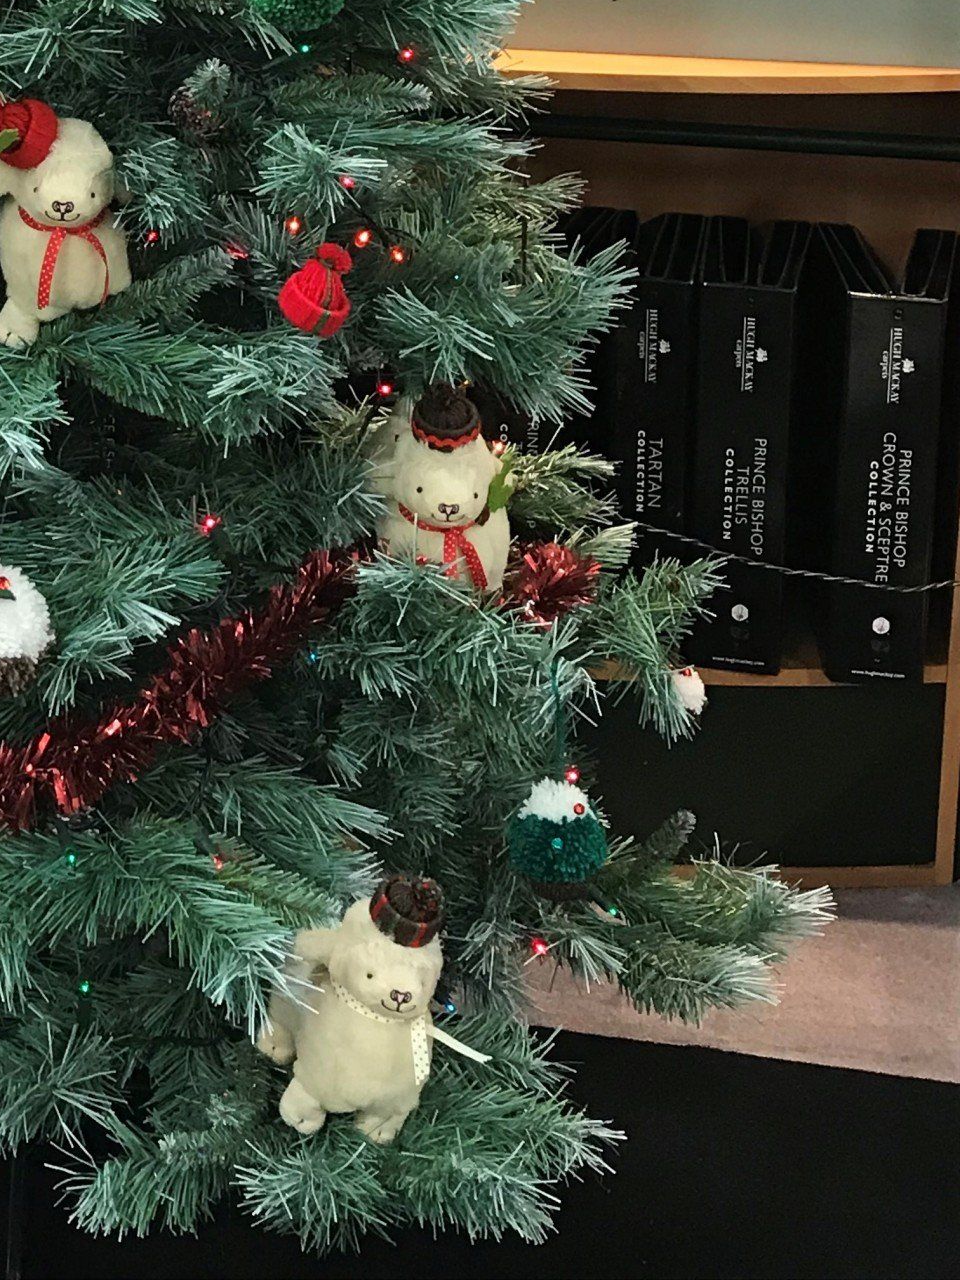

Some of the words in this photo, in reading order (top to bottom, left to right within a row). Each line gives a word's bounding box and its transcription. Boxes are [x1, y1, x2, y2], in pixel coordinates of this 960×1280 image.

[636, 430, 646, 512] COLLECTION
[647, 438, 663, 508] TARTAN
[723, 448, 734, 540] COLLECTION
[752, 438, 767, 494] PRINCE
[880, 432, 897, 496] CROWN
[896, 449, 912, 506] PRINCE
[735, 466, 750, 525] TRELLIS
[865, 460, 879, 553] COLLECTION
[879, 501, 892, 512] &
[750, 500, 765, 555] BISHOP
[875, 518, 892, 583] SCEPTRE
[893, 511, 909, 568] BISHOP
